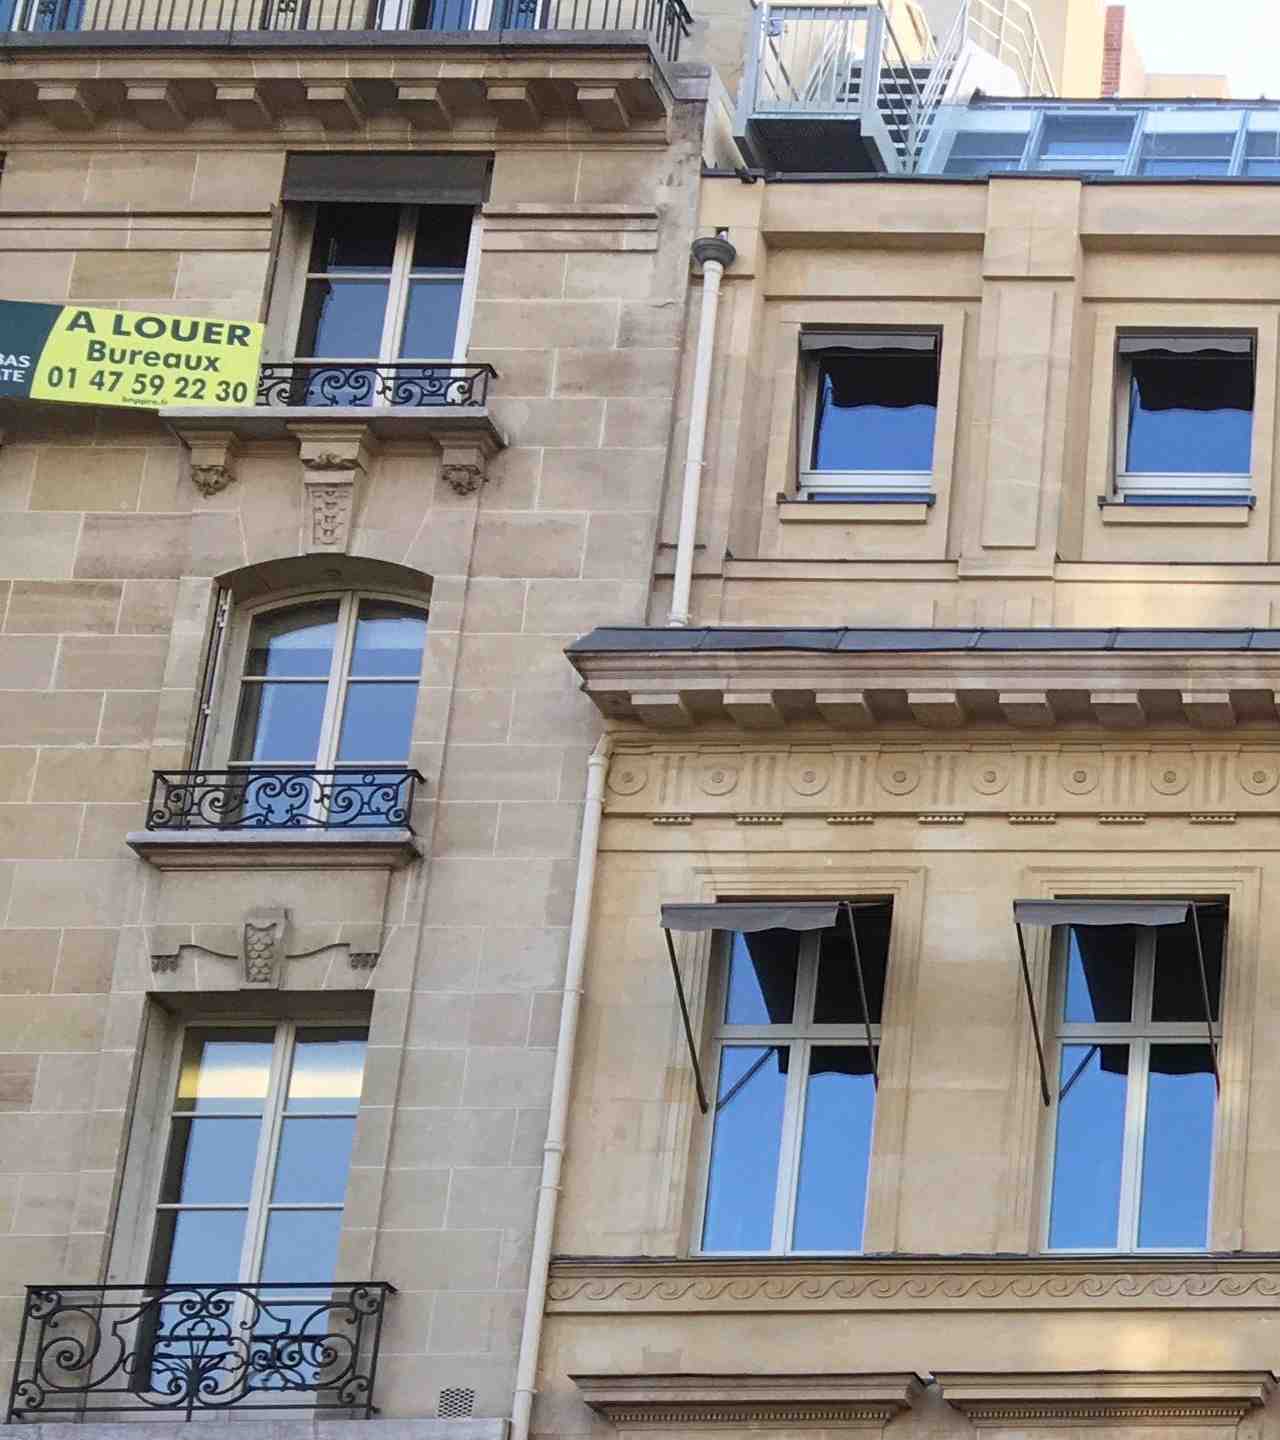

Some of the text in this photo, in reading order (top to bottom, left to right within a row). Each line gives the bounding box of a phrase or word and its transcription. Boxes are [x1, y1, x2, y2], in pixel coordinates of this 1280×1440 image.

[65, 310, 251, 347] A LOUER
[86, 339, 220, 372] Bureaux
[47, 366, 248, 403] 01 47 59 22 30
